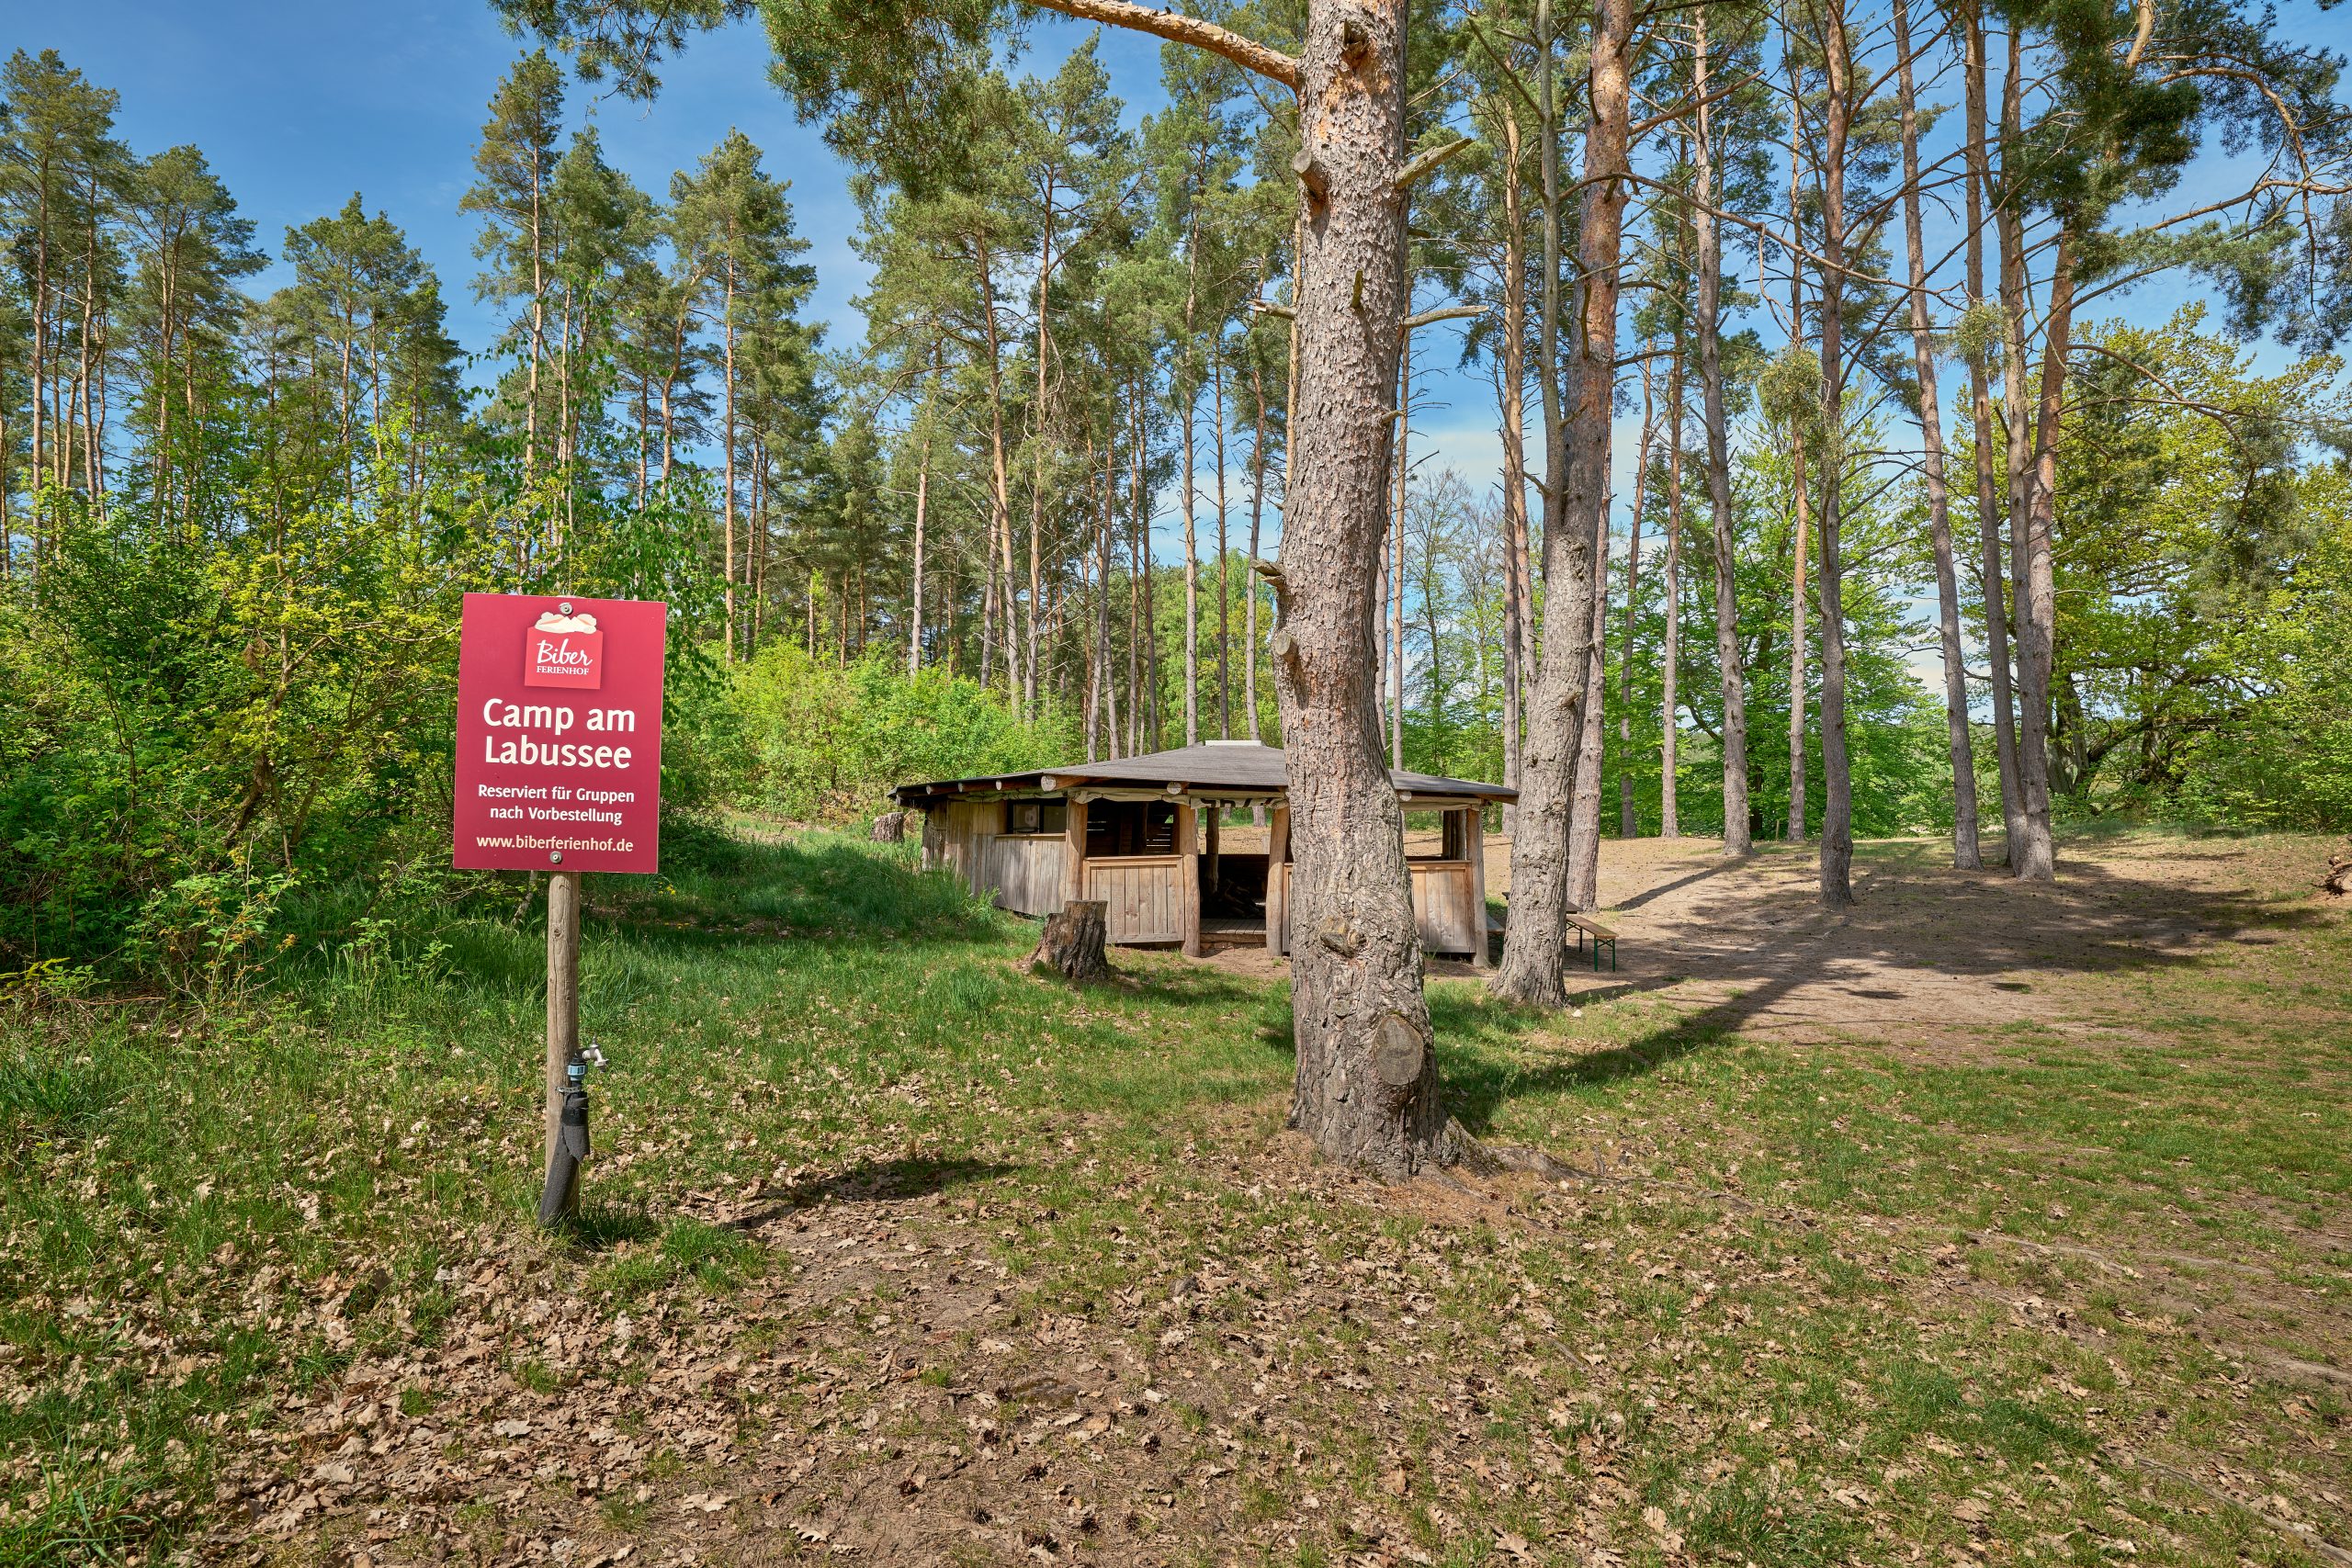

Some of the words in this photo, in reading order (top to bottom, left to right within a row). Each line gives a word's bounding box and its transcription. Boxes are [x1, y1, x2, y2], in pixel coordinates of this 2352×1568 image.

[537, 638, 593, 666] Biber
[536, 665, 590, 676] FERIENHOF
[483, 698, 574, 736] Camp
[586, 708, 636, 732] am
[485, 734, 632, 769] Labussee
[478, 784, 548, 800] Reserviert
[551, 785, 571, 800] für
[576, 787, 635, 804] Gruppen
[490, 806, 524, 819] nach
[528, 807, 623, 826] Vorbestellung
[476, 834, 634, 852] www.biberferienhof.de
